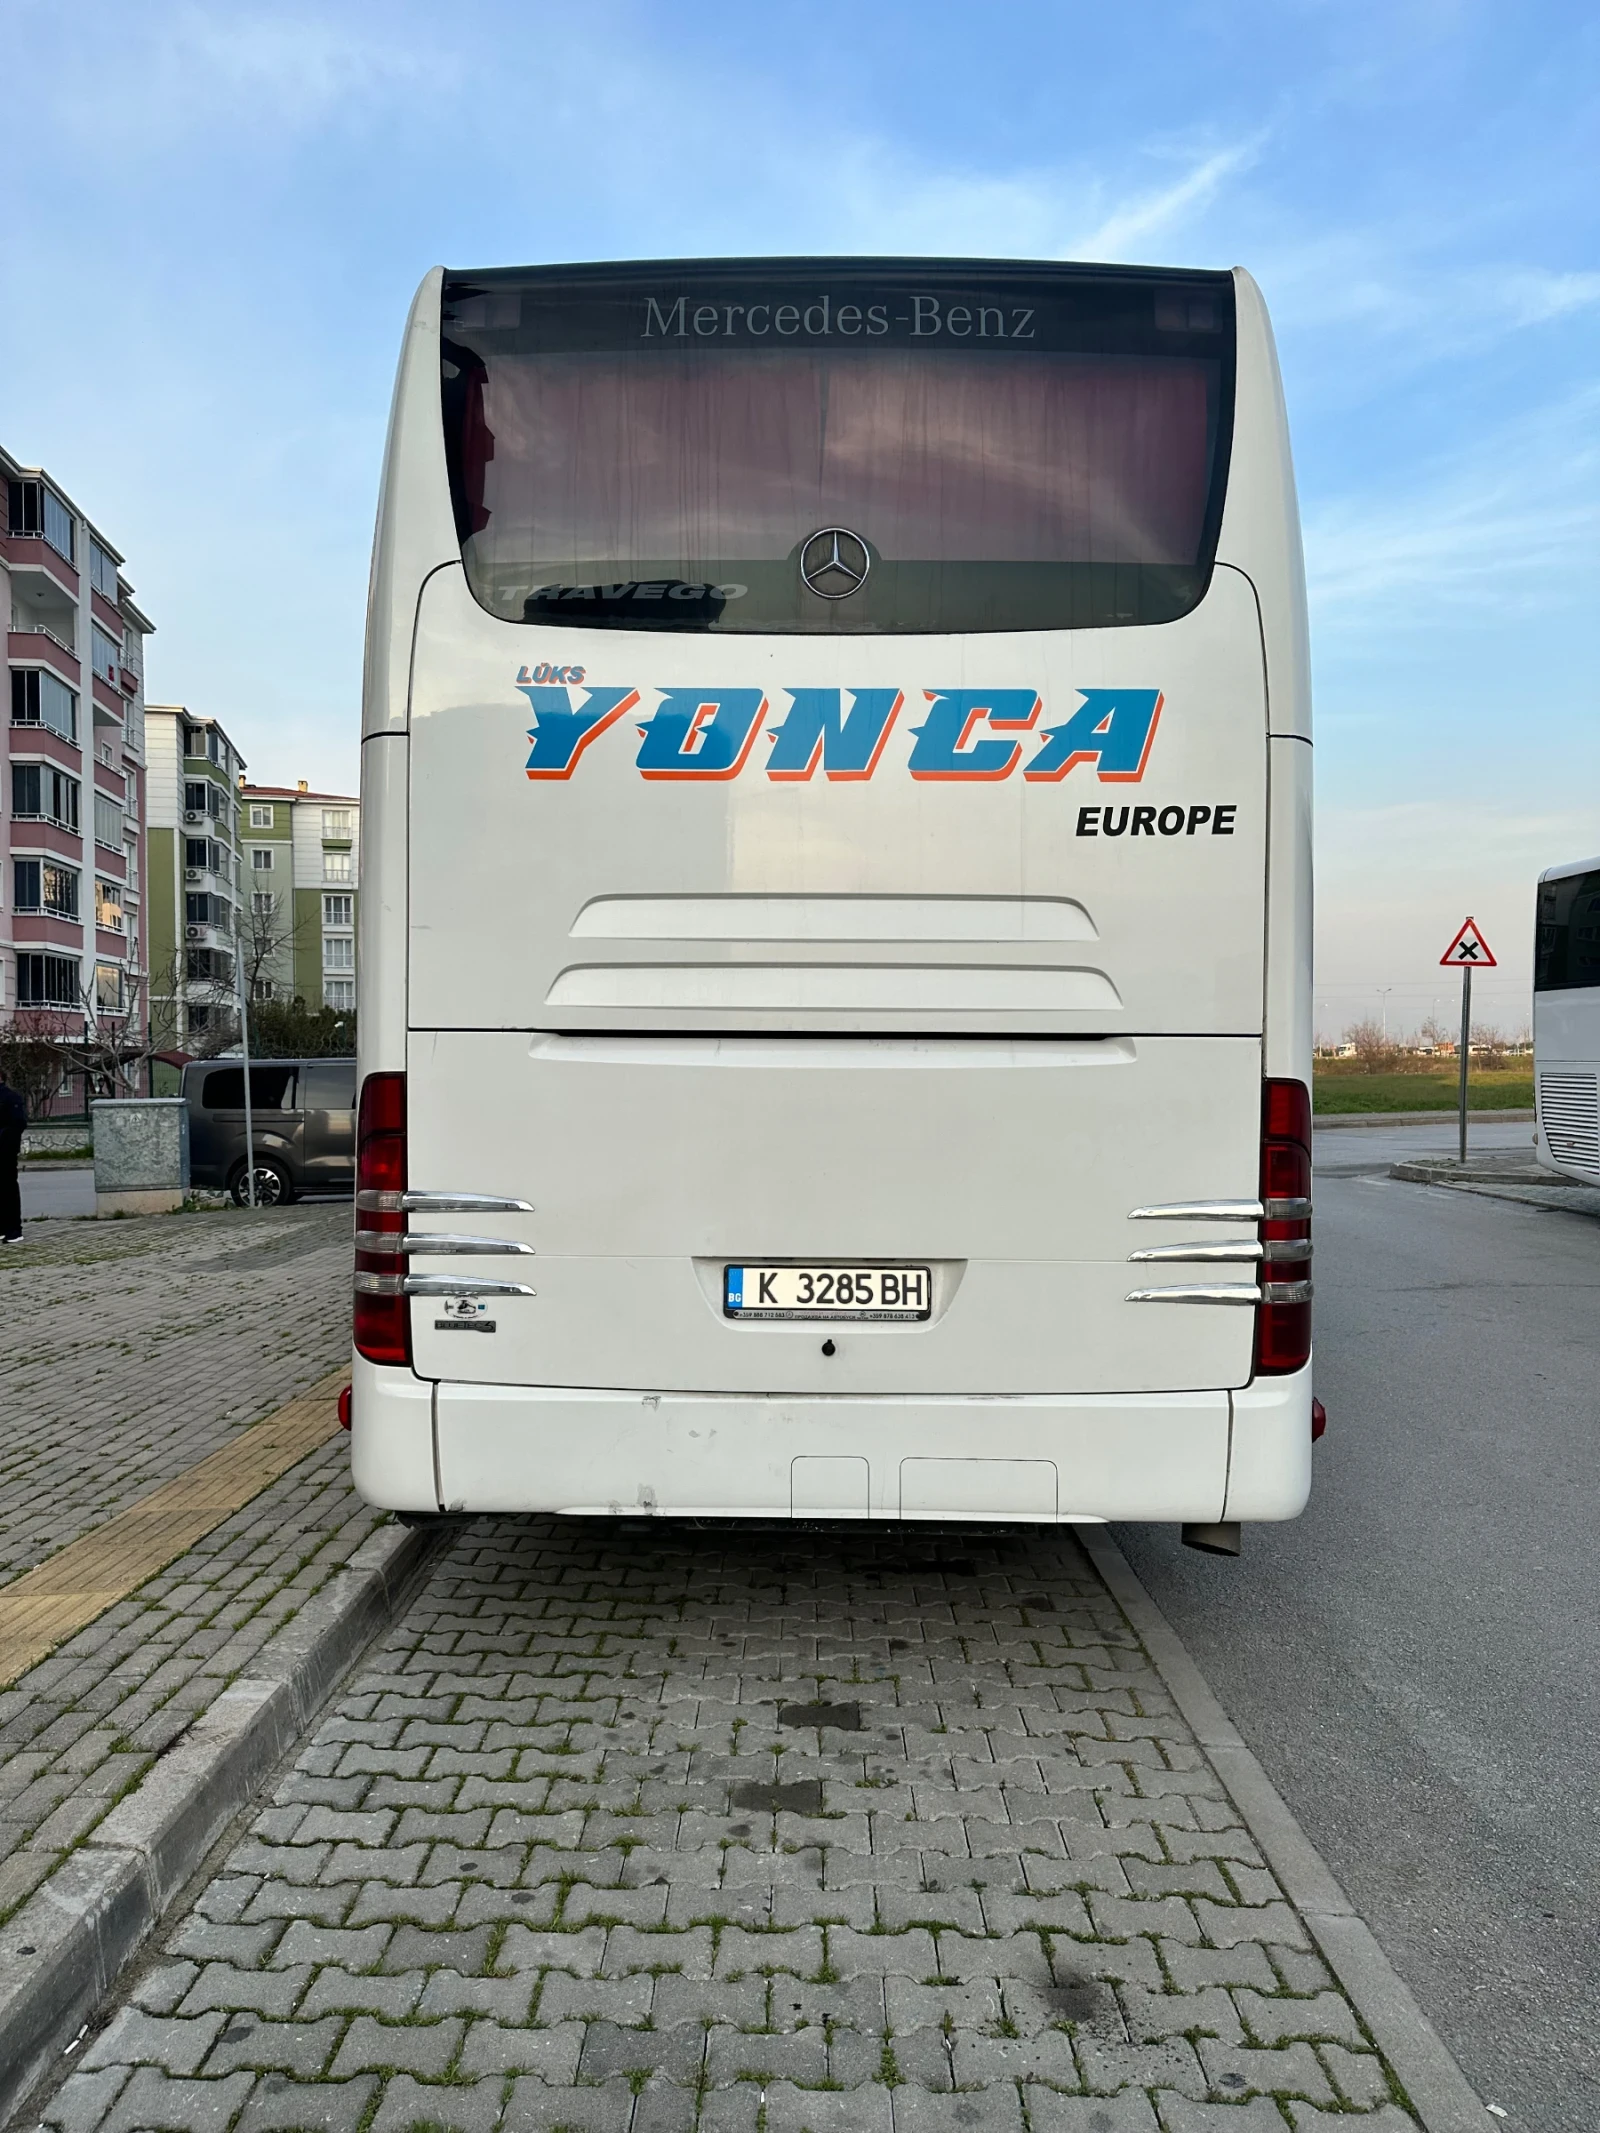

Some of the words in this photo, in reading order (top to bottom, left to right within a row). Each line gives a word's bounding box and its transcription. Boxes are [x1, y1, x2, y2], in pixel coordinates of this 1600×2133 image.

[640, 295, 1035, 338] Mercedes-Benz
[497, 583, 748, 600] TRAVEGO
[516, 662, 586, 684] LÜKS
[514, 686, 1164, 782] YONCA
[1075, 805, 1237, 837] EUROPE
[728, 1293, 742, 1302] BG
[759, 1273, 778, 1303] K
[797, 1273, 874, 1304] 3285
[881, 1274, 922, 1305] BH
